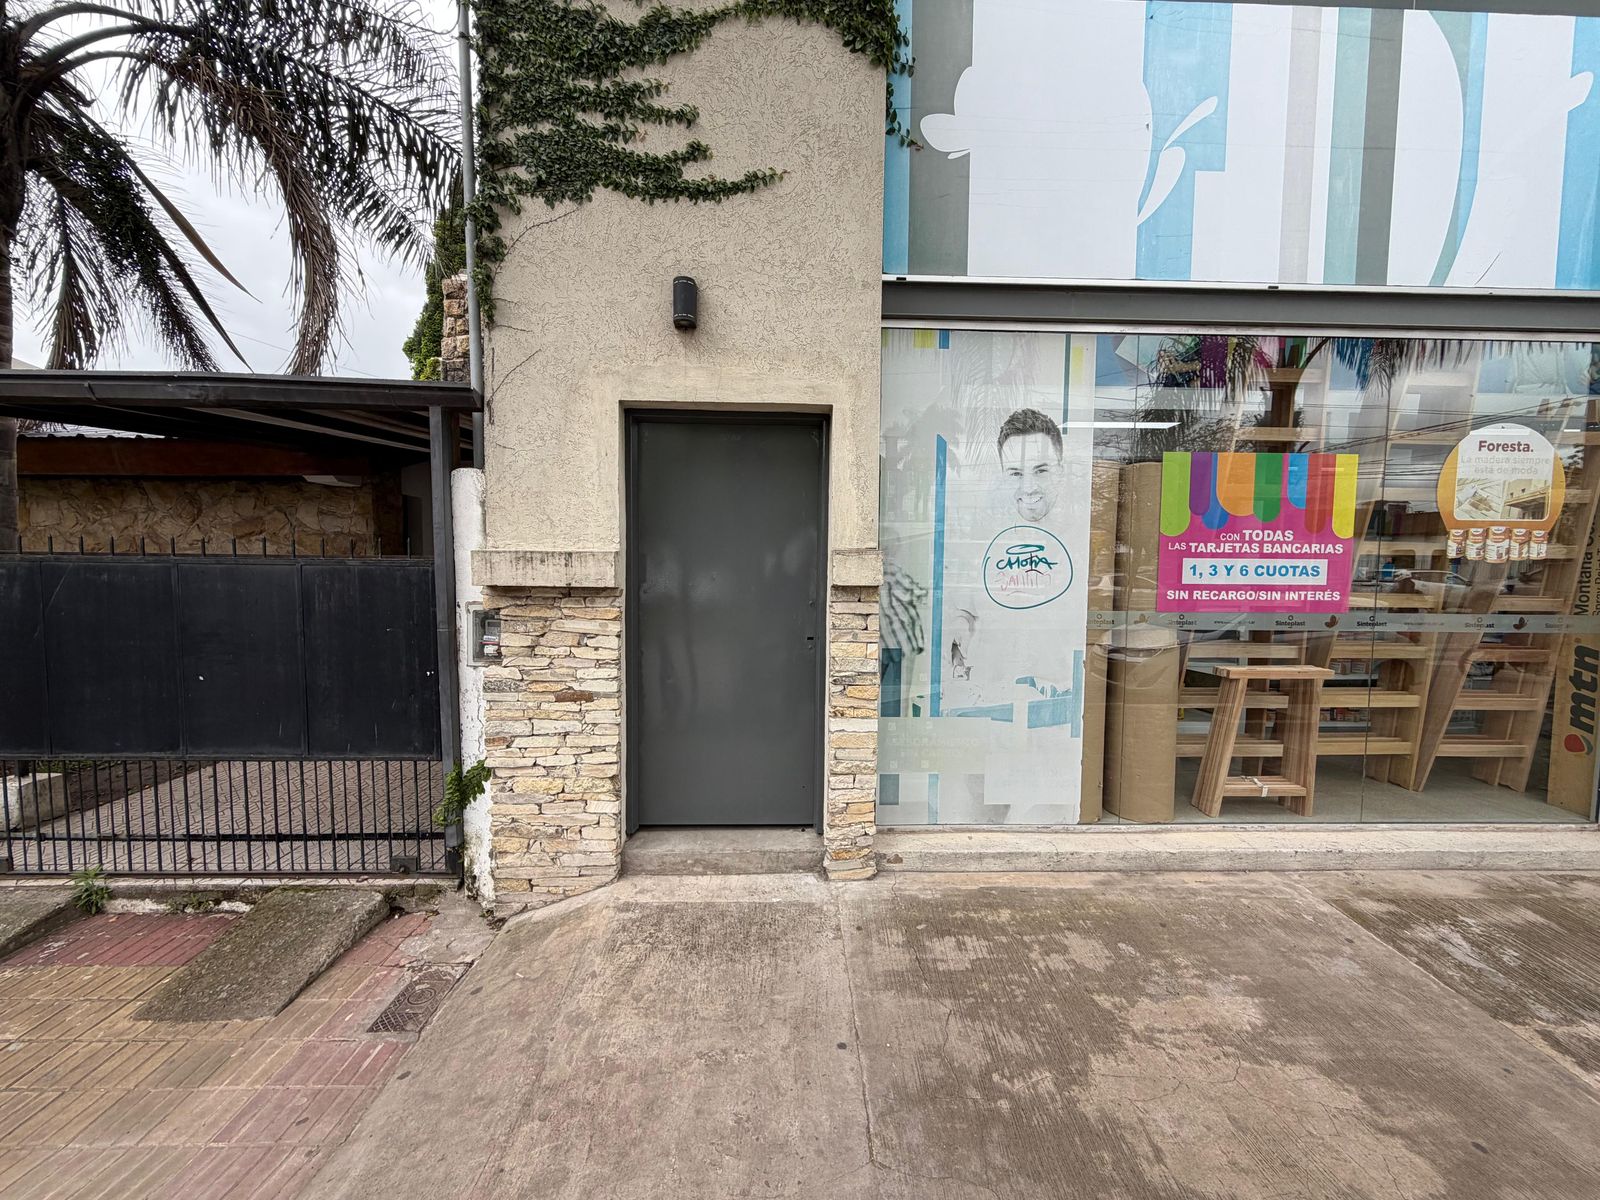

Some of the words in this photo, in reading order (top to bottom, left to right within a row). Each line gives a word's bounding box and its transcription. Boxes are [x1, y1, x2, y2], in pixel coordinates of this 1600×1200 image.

[1478, 440, 1534, 453] Foresta.
[1220, 532, 1240, 541] CON
[1242, 529, 1294, 542] TODAS
[1168, 542, 1187, 550] LAS
[1189, 542, 1260, 554] TARJETAS
[1262, 543, 1344, 555] BANCARIAS
[1189, 564, 1203, 579] 1,
[1208, 564, 1218, 576] 3
[1223, 564, 1234, 576] Y
[1239, 565, 1249, 576] 6
[1254, 565, 1321, 577] CUOTAS
[1166, 590, 1189, 600] SIN
[1192, 590, 1281, 601] RECARGO/SIN
[1285, 589, 1341, 601] INTERÉS
[1569, 644, 1600, 736] mtn
